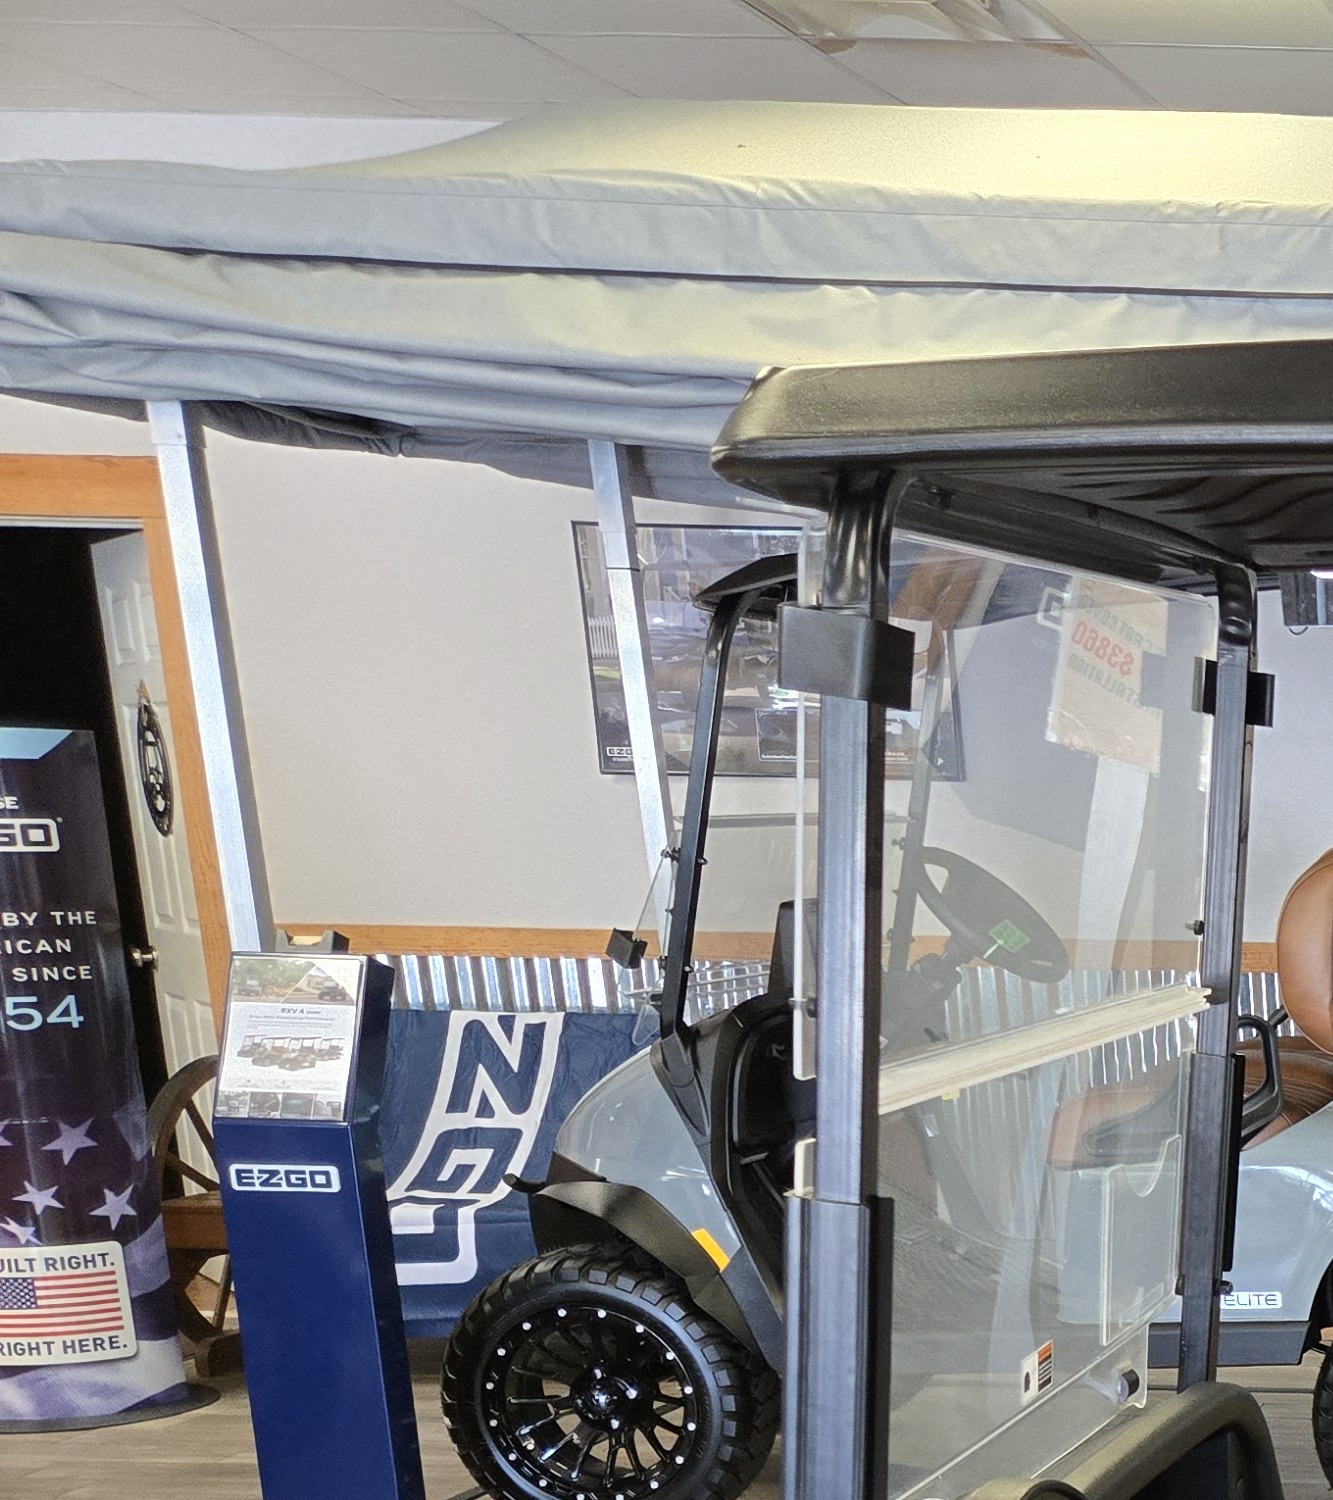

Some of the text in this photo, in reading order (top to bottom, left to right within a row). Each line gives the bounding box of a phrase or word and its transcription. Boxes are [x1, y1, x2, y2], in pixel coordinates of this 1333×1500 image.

[0, 821, 57, 849] GO
[3, 911, 97, 927] BY THE
[2, 938, 71, 954] ICAN
[12, 965, 92, 982] SINCE
[5, 994, 84, 1030] 54
[233, 1168, 334, 1190] EZGO
[44, 1252, 115, 1272] RIGHT.
[1223, 1292, 1279, 1306] ELITE
[62, 1335, 128, 1354] HERE.
